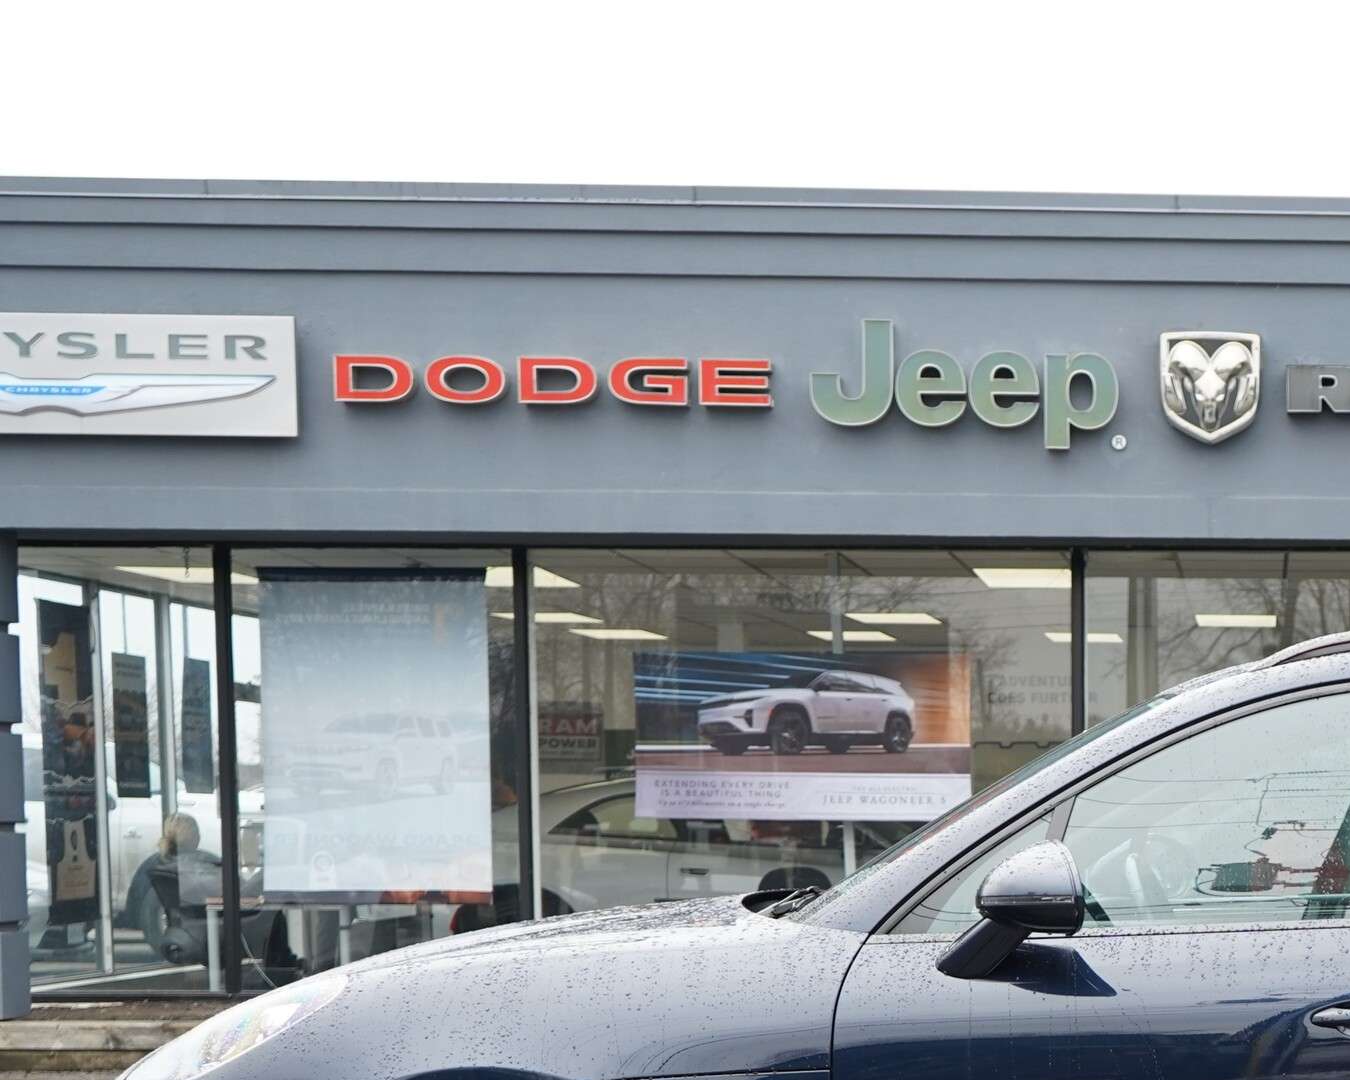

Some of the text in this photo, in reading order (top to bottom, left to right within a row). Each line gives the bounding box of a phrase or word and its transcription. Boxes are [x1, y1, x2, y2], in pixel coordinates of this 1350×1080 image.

[333, 354, 774, 408] DODGE
[809, 318, 1120, 450] Jeep
[539, 718, 598, 734] RAM
[654, 779, 790, 789] EXTENDING EVERY DRIVE
[660, 789, 670, 797] IS
[674, 789, 681, 797] A
[685, 789, 743, 798] BEAUTIFUL
[822, 794, 853, 806] JEEP
[859, 795, 933, 805] WAGONEER
